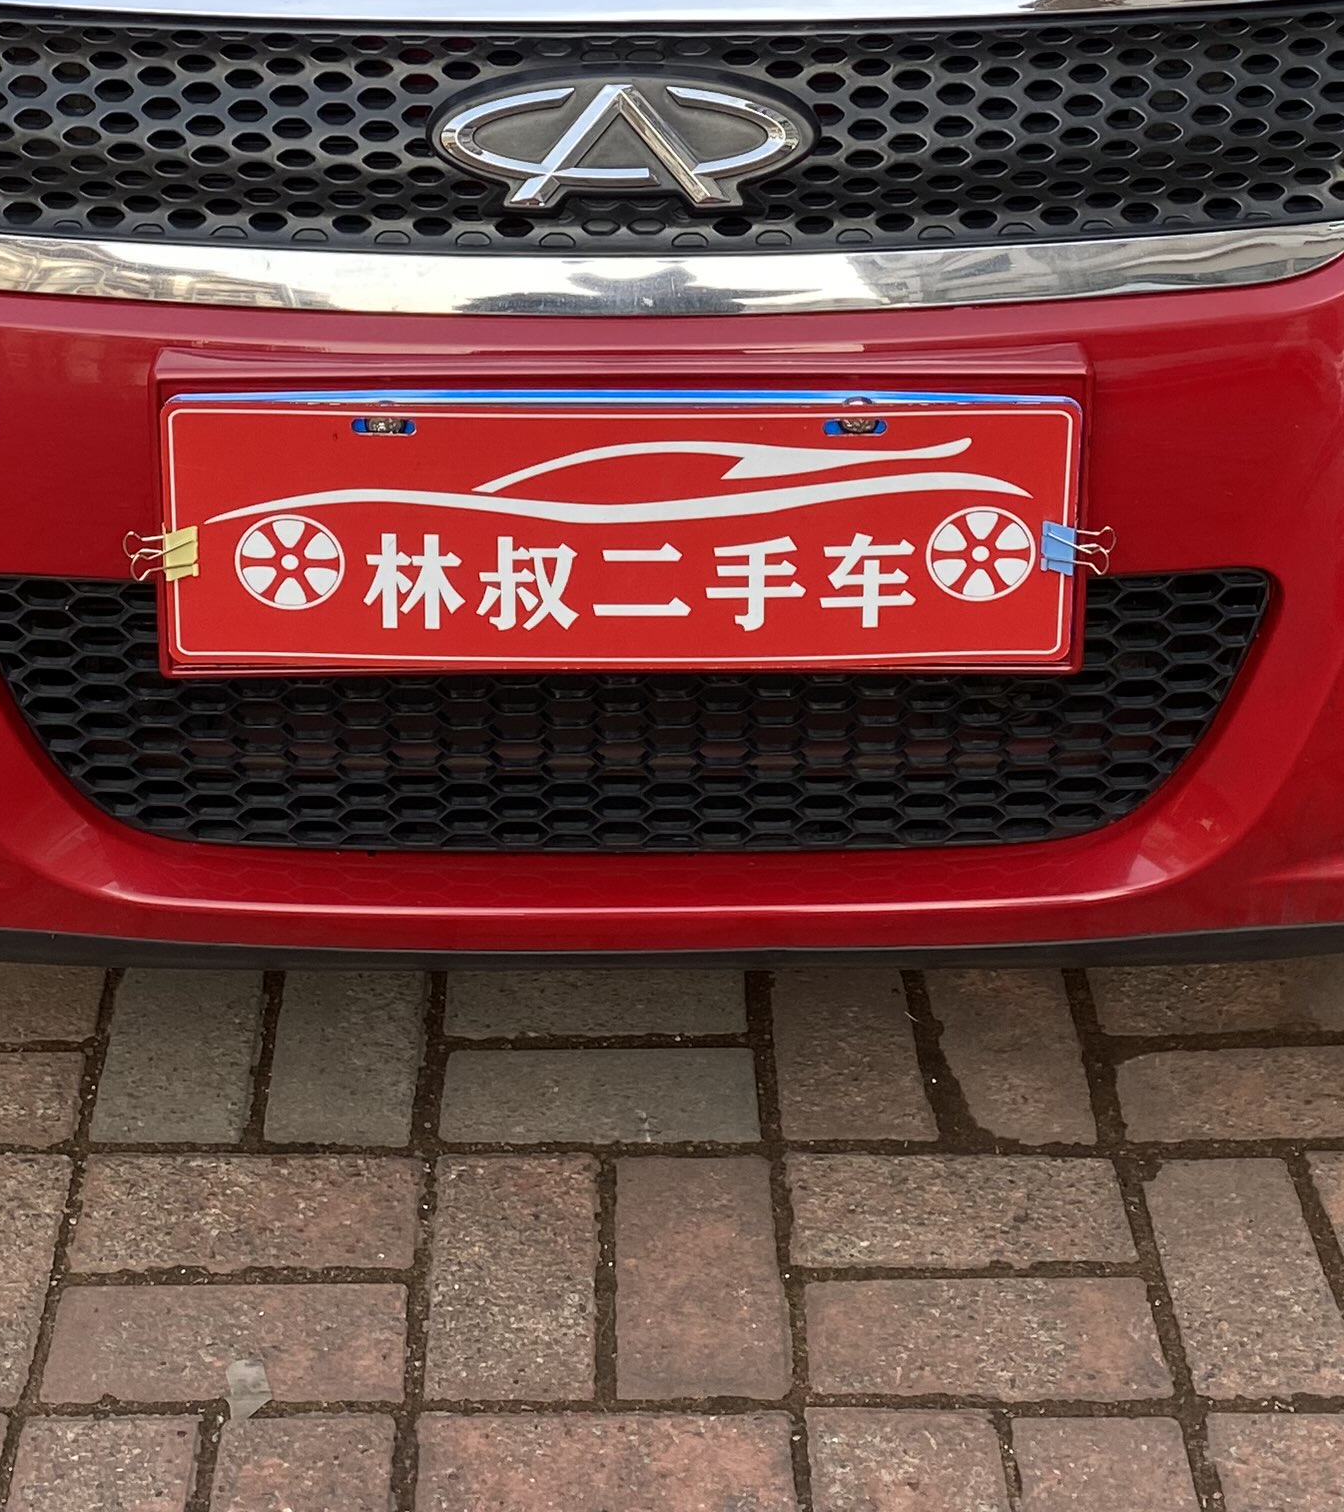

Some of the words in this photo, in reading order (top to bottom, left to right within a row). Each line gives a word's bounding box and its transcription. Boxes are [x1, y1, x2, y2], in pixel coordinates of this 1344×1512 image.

[363, 532, 917, 632] 林叔二手车
